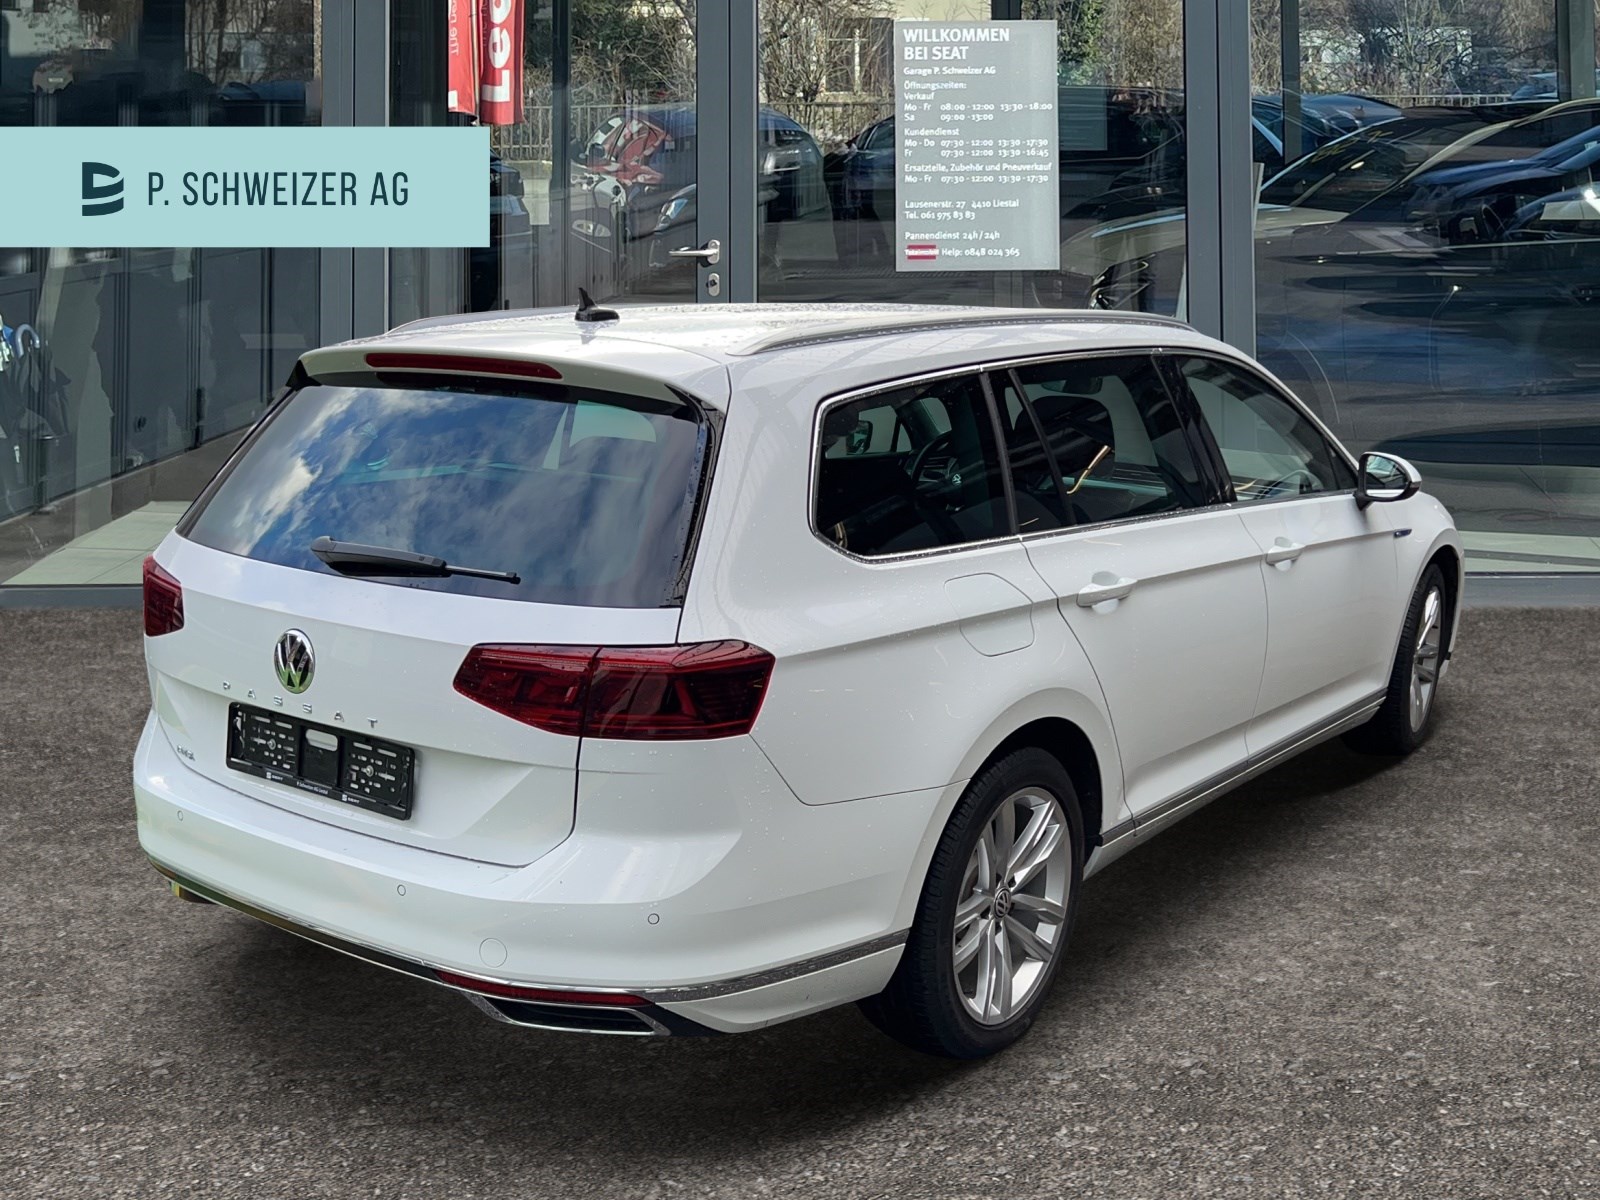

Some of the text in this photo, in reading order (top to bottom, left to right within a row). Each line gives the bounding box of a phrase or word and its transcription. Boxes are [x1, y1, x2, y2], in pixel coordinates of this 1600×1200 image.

[903, 28, 1010, 42] WILLKOMMEN
[904, 46, 969, 60] BEI SEAT
[903, 67, 932, 76] Garage
[942, 66, 982, 75] Schweizer
[904, 80, 967, 91] Öffnungszeiten:
[904, 92, 935, 100] Verkauf
[904, 103, 917, 111] Mo
[924, 103, 931, 111] Fr
[972, 103, 995, 111] 12:00
[1000, 104, 1023, 112] 13:30
[1029, 103, 1052, 111] 18:00
[904, 113, 915, 121] Sa
[940, 114, 965, 122] 09:00
[972, 114, 994, 122] 13:00
[904, 128, 960, 136] Kundendienst
[905, 139, 917, 147] Mo
[924, 139, 935, 147] Do
[940, 139, 964, 147] 07:30
[971, 139, 993, 147] 12:00
[998, 139, 1021, 147] 13:30
[1027, 139, 1048, 147] 17:30
[905, 149, 912, 157] Fr
[940, 150, 964, 158] 07:30
[998, 149, 1020, 158] 13:30
[1027, 149, 1049, 158] 16:45
[904, 163, 1052, 172] Ersatzteile, Zubehör und Pneuverkauf
[905, 175, 917, 183] Mo
[940, 175, 964, 184] 07:30
[998, 175, 1020, 184] 13:30
[1027, 175, 1048, 184] 17:30
[905, 199, 1019, 209] Lausenerstr. 27 4410 Liestal
[905, 211, 975, 221] Tel. 061 975 83 83
[905, 232, 960, 240] Pannendienst
[963, 231, 977, 240] 24h
[984, 231, 1000, 240] 24h
[942, 248, 963, 257] Help:
[964, 248, 986, 256] 0848
[987, 248, 1003, 257] 024
[1005, 248, 1020, 257] 365
[222, 680, 379, 728] PASSAT
